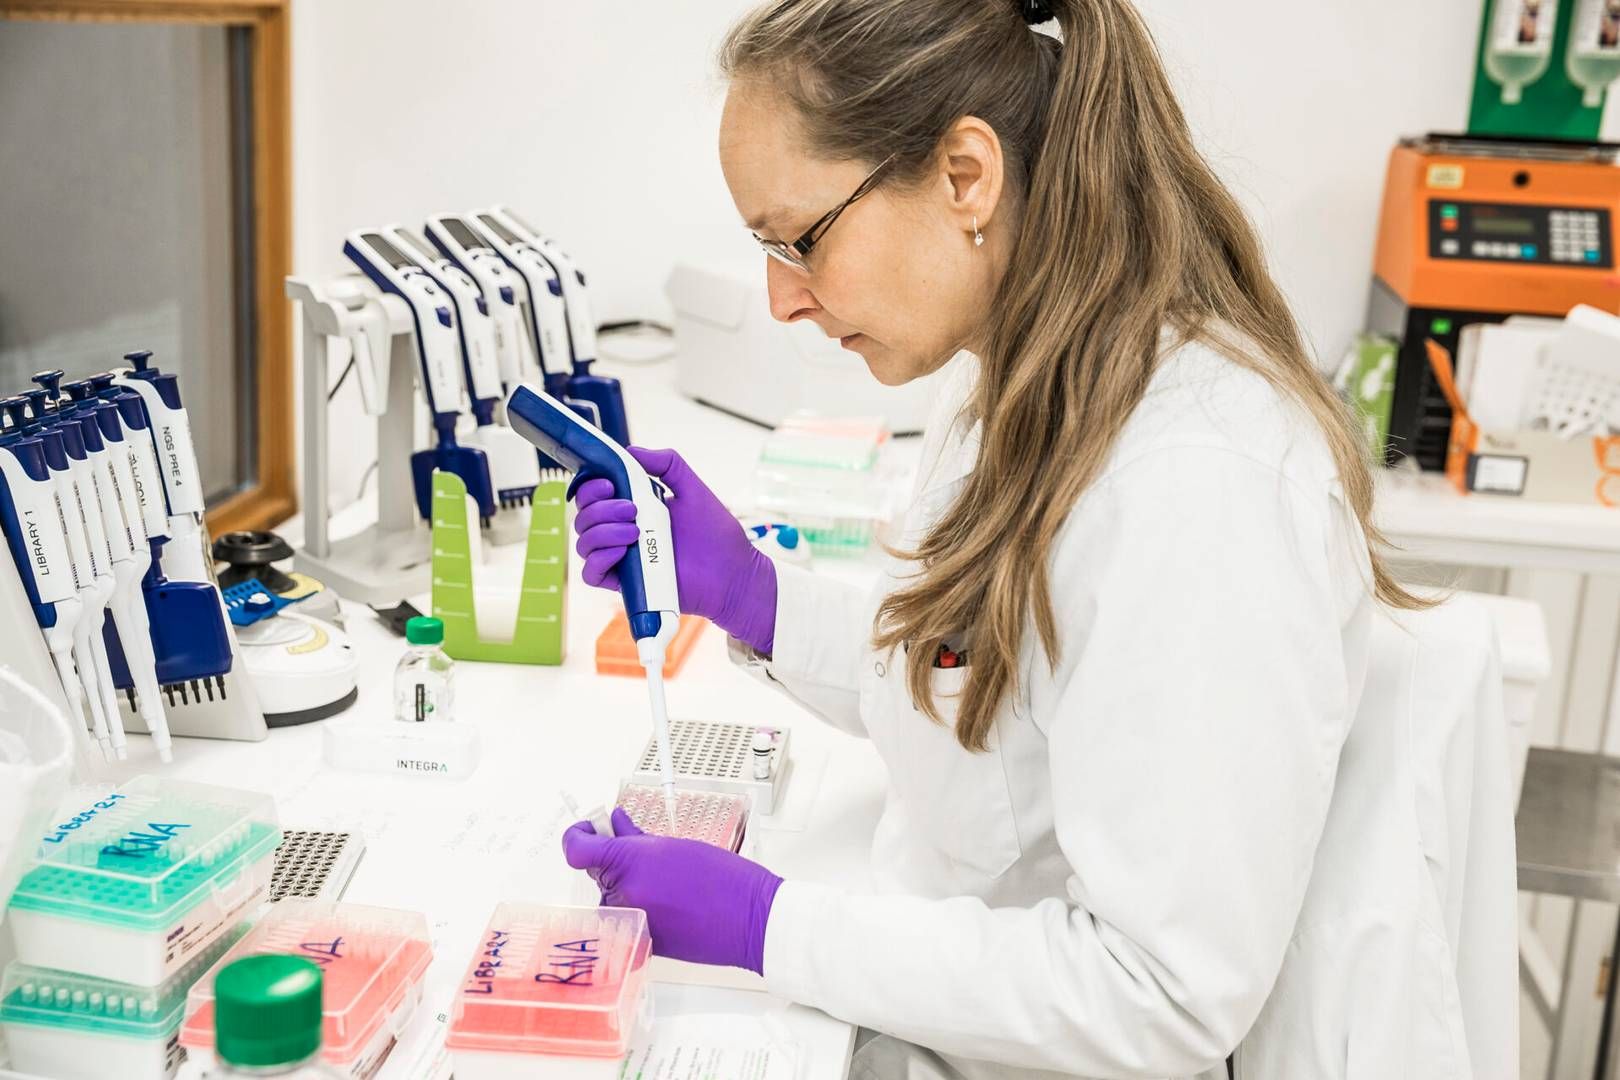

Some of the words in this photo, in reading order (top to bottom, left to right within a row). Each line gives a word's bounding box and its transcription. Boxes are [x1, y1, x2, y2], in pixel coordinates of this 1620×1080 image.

[162, 426, 175, 451] NGS
[169, 454, 180, 477] PRE
[27, 521, 50, 575] LIBRARY
[646, 538, 659, 563] NGS
[396, 760, 448, 772] INTEGRA
[102, 823, 192, 858] RNA
[535, 939, 600, 986] RNA
